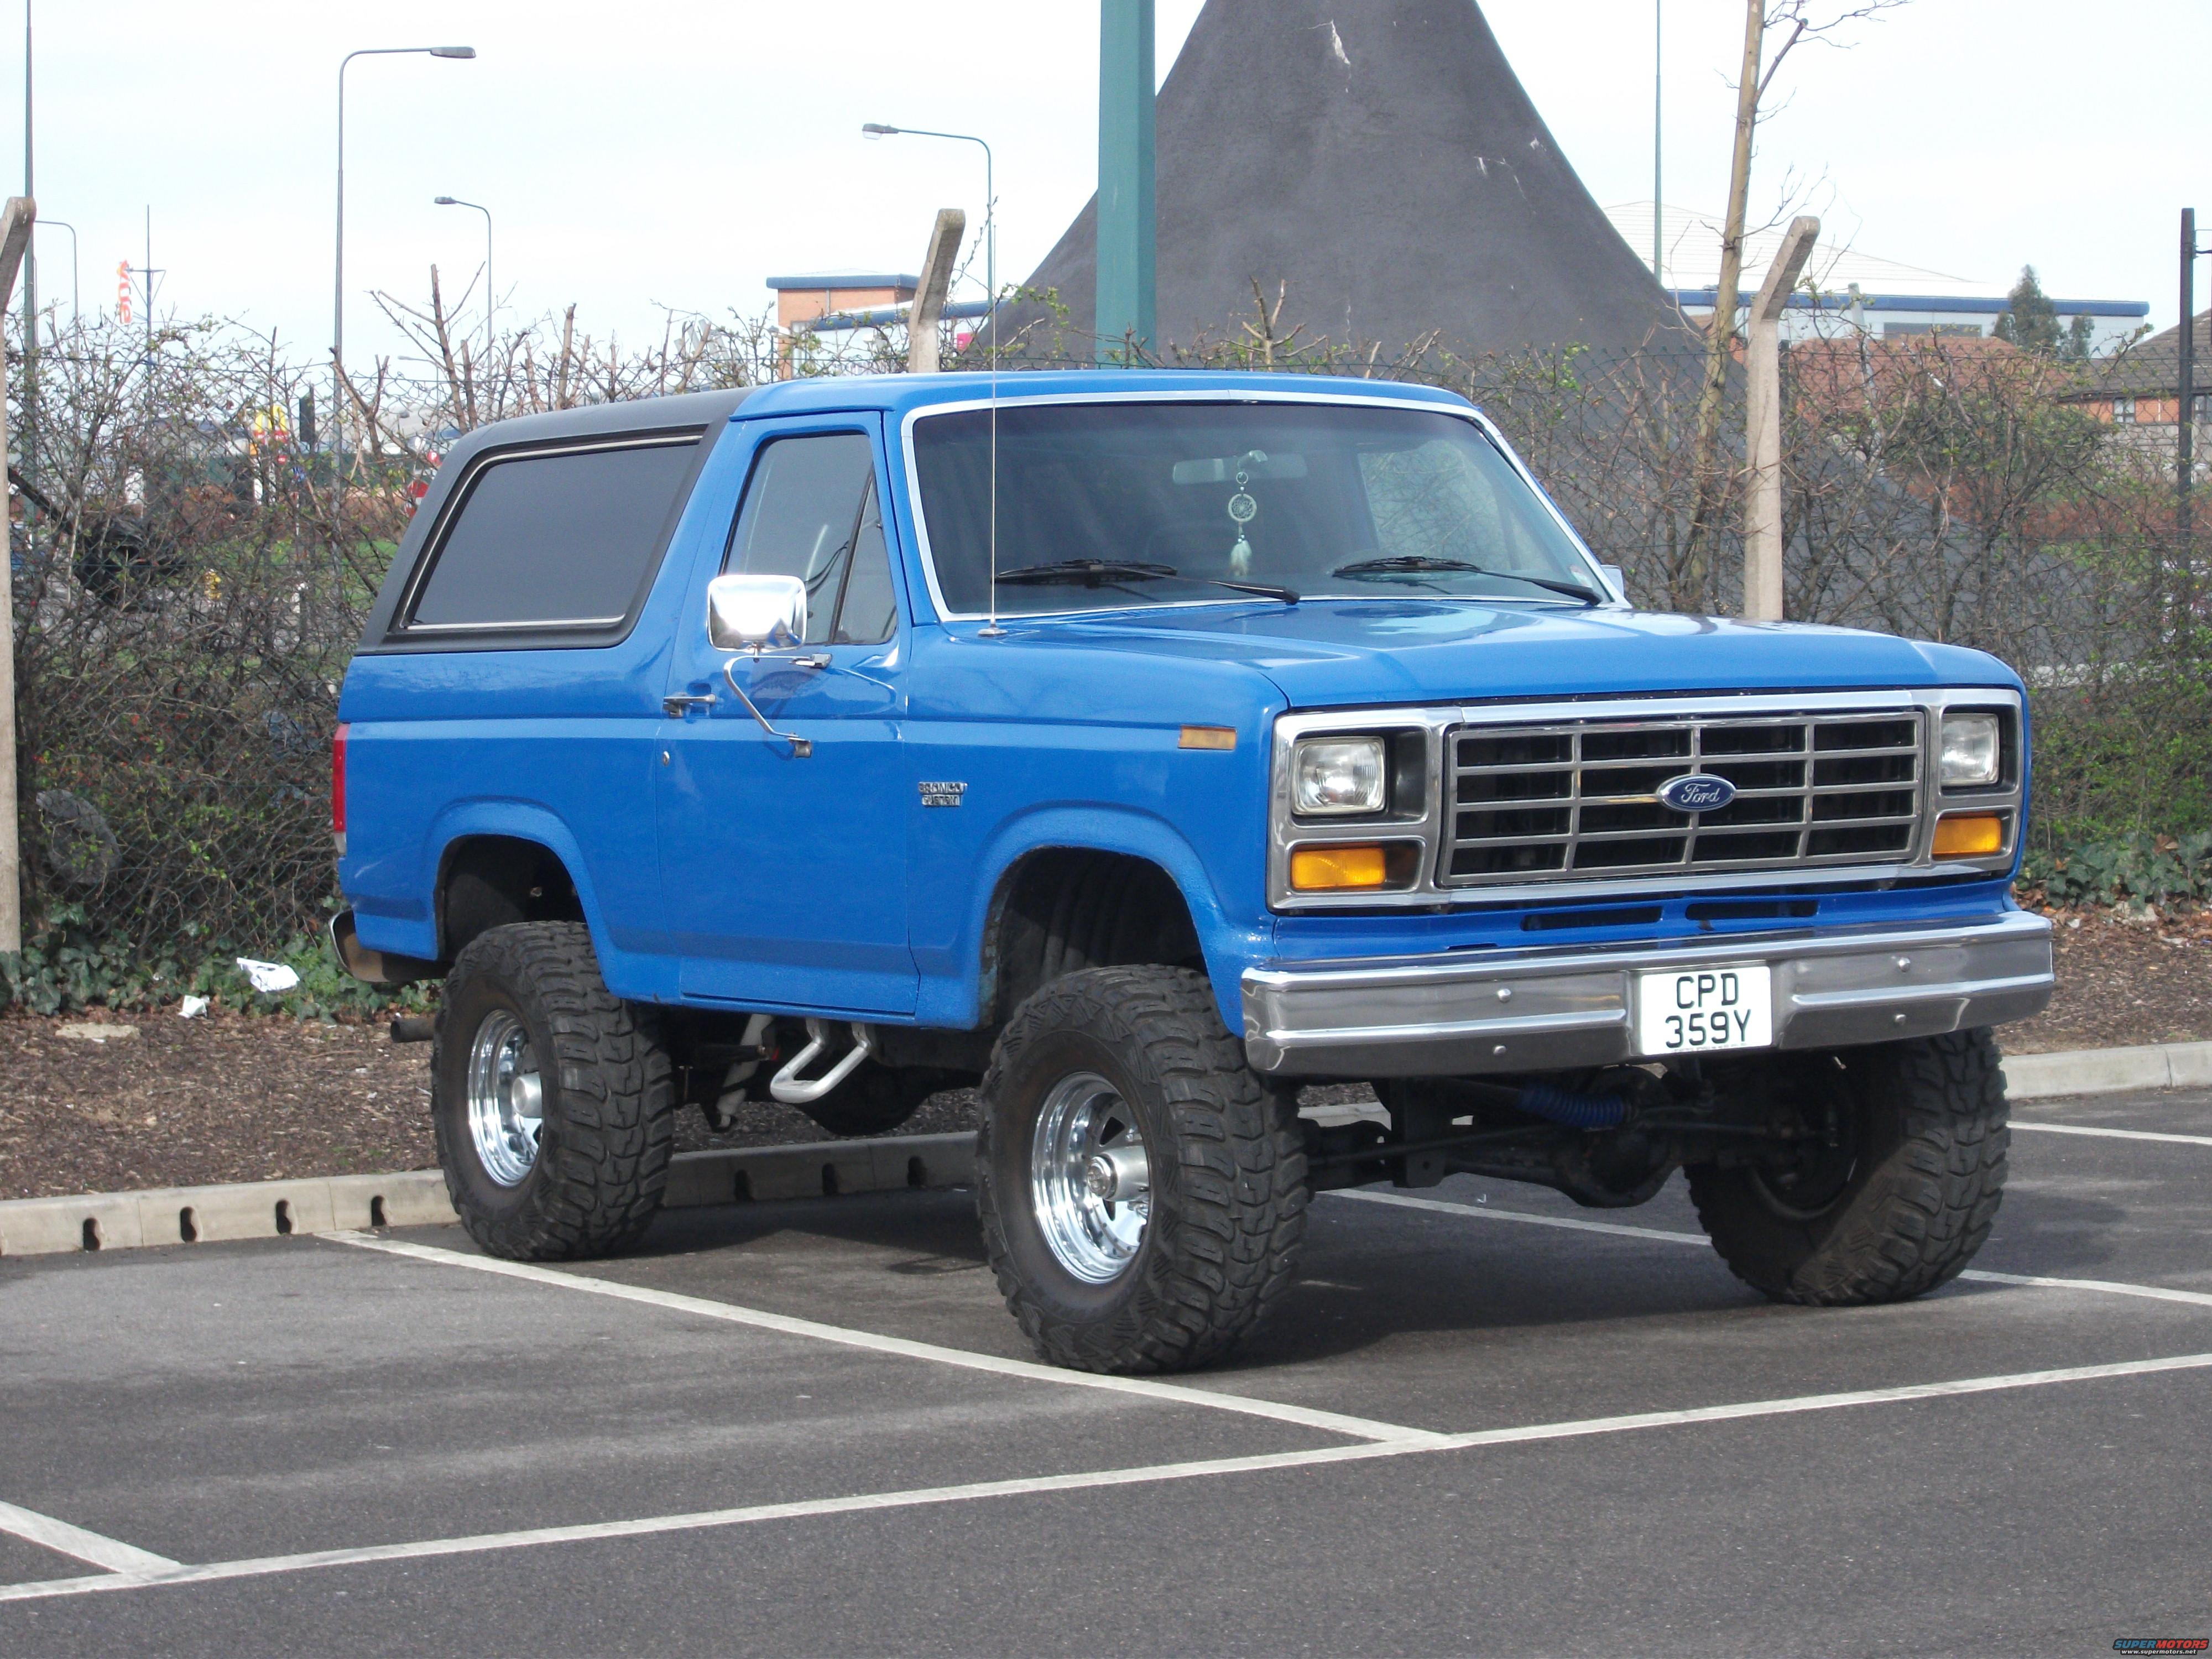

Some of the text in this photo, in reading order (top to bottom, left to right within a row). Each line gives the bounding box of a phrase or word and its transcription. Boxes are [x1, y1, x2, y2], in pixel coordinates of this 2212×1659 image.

[919, 782, 964, 794] BRONCO
[1681, 782, 1720, 804] Ford
[1676, 972, 1739, 1009] CPD
[1665, 1008, 1751, 1048] 359Y
